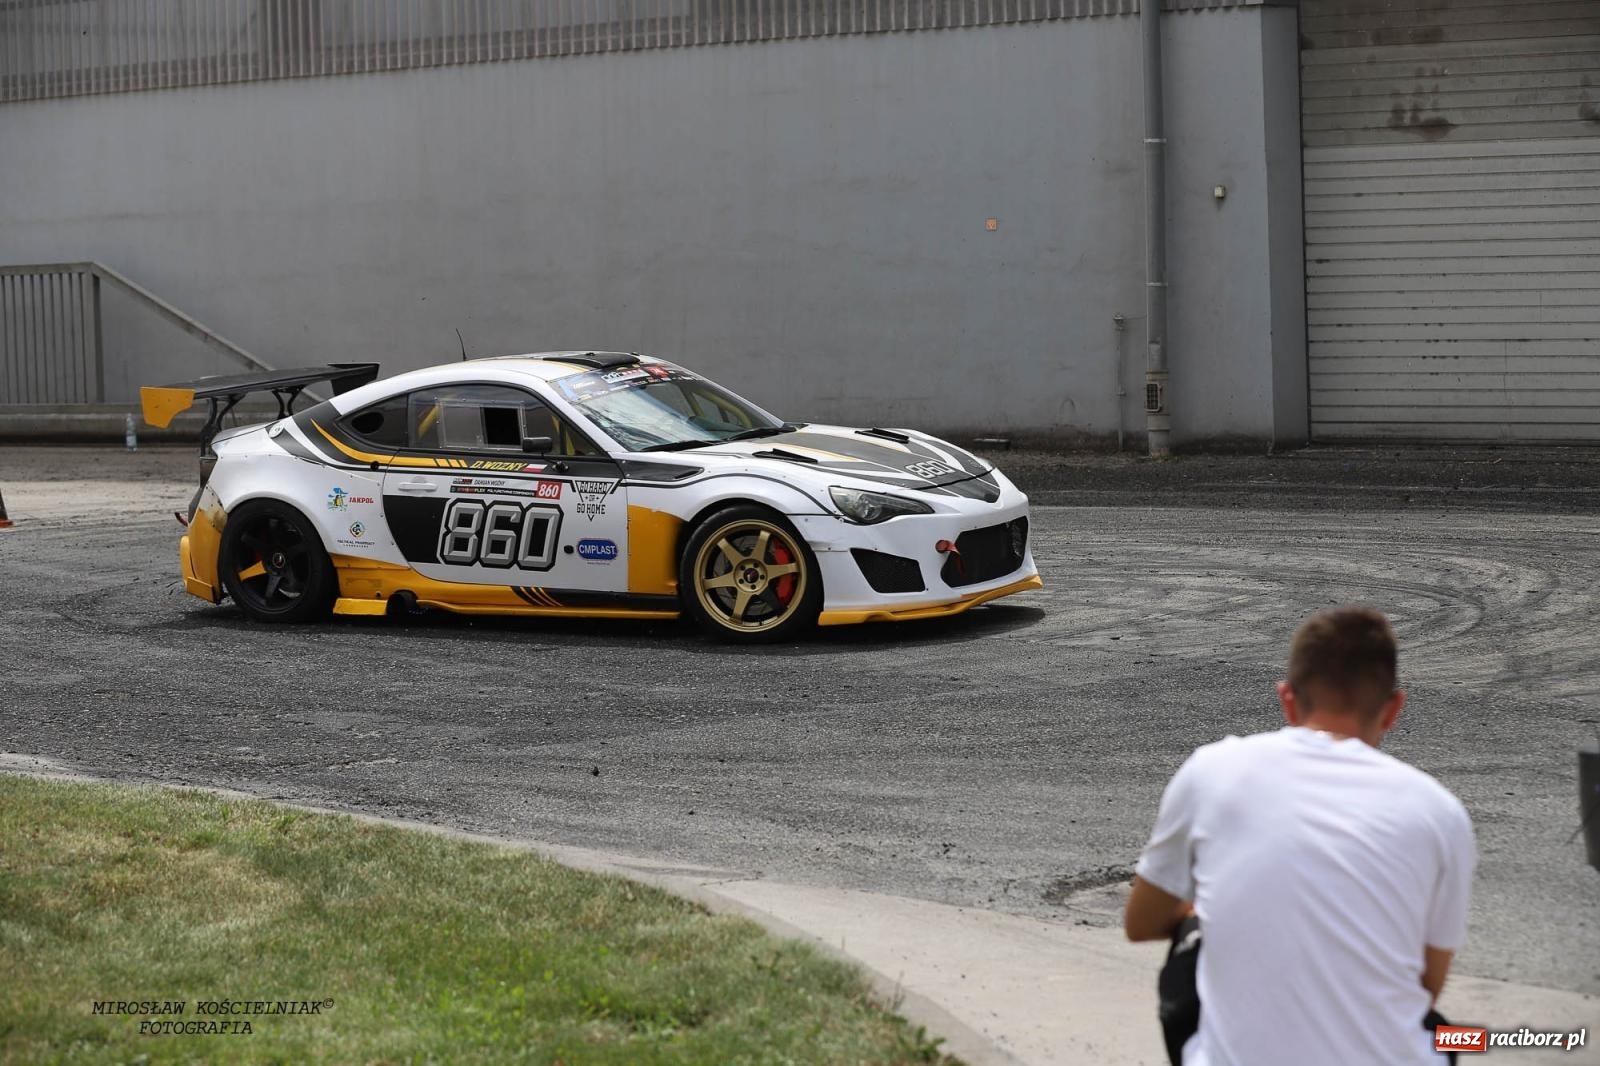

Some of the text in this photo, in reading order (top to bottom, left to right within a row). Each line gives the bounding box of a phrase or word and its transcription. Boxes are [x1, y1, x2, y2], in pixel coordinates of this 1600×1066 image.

[905, 460, 956, 479] 860
[538, 483, 560, 498] 860
[576, 503, 606, 515] GO HOME
[440, 498, 564, 572] 860
[579, 544, 616, 555] CMPLAST
